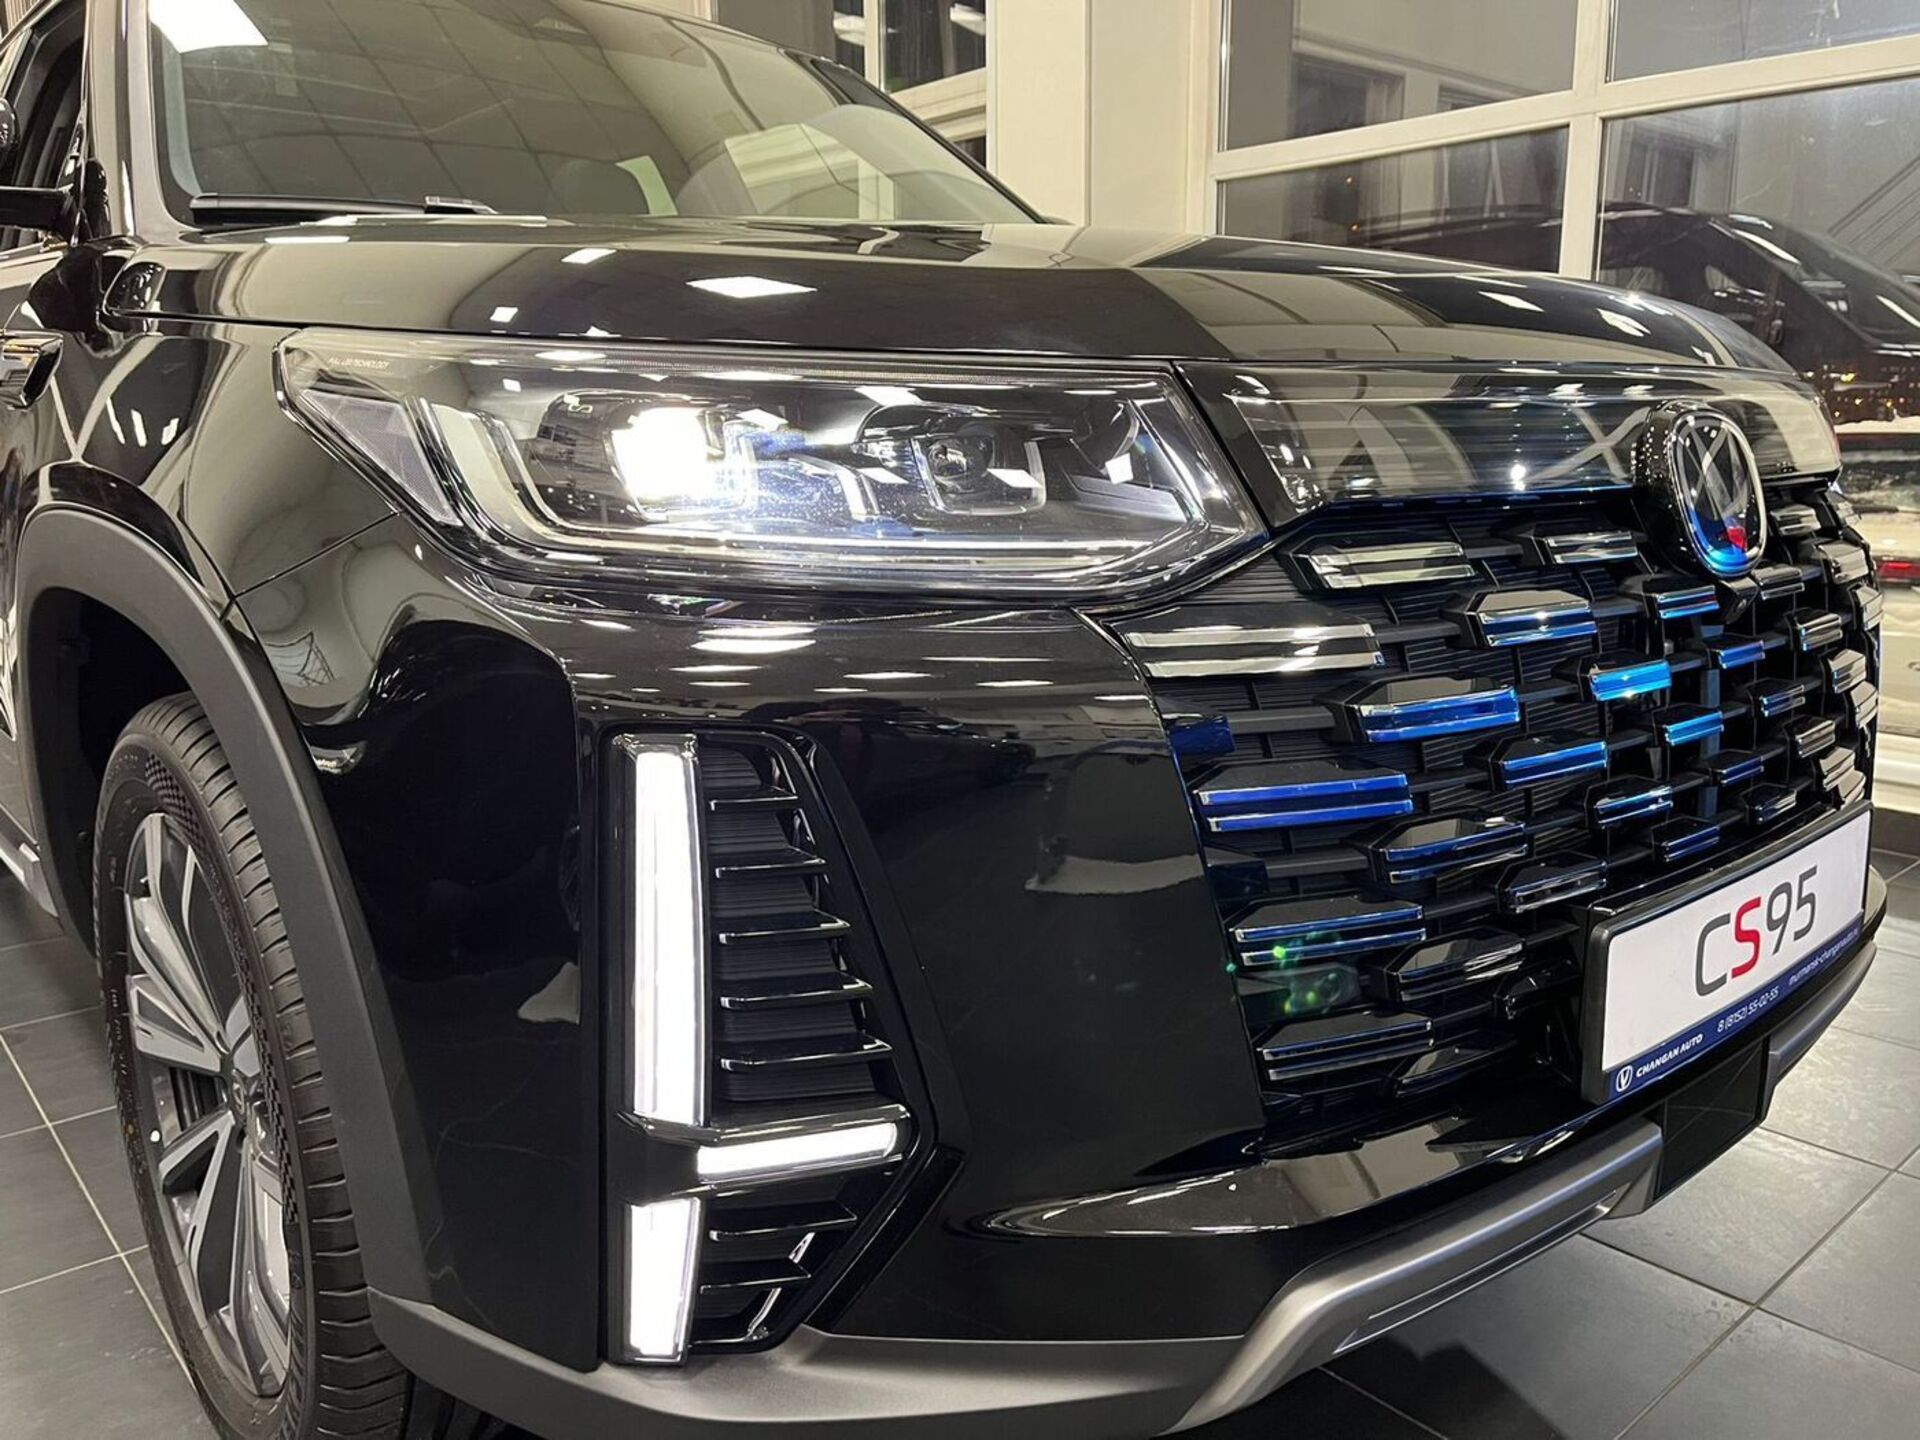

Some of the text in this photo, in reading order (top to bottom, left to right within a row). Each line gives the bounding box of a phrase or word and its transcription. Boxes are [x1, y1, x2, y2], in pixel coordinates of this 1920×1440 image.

[1695, 865, 1818, 997] CS95
[1635, 1046, 1680, 1078] CHANGAN
[1679, 1033, 1704, 1054] AUTO
